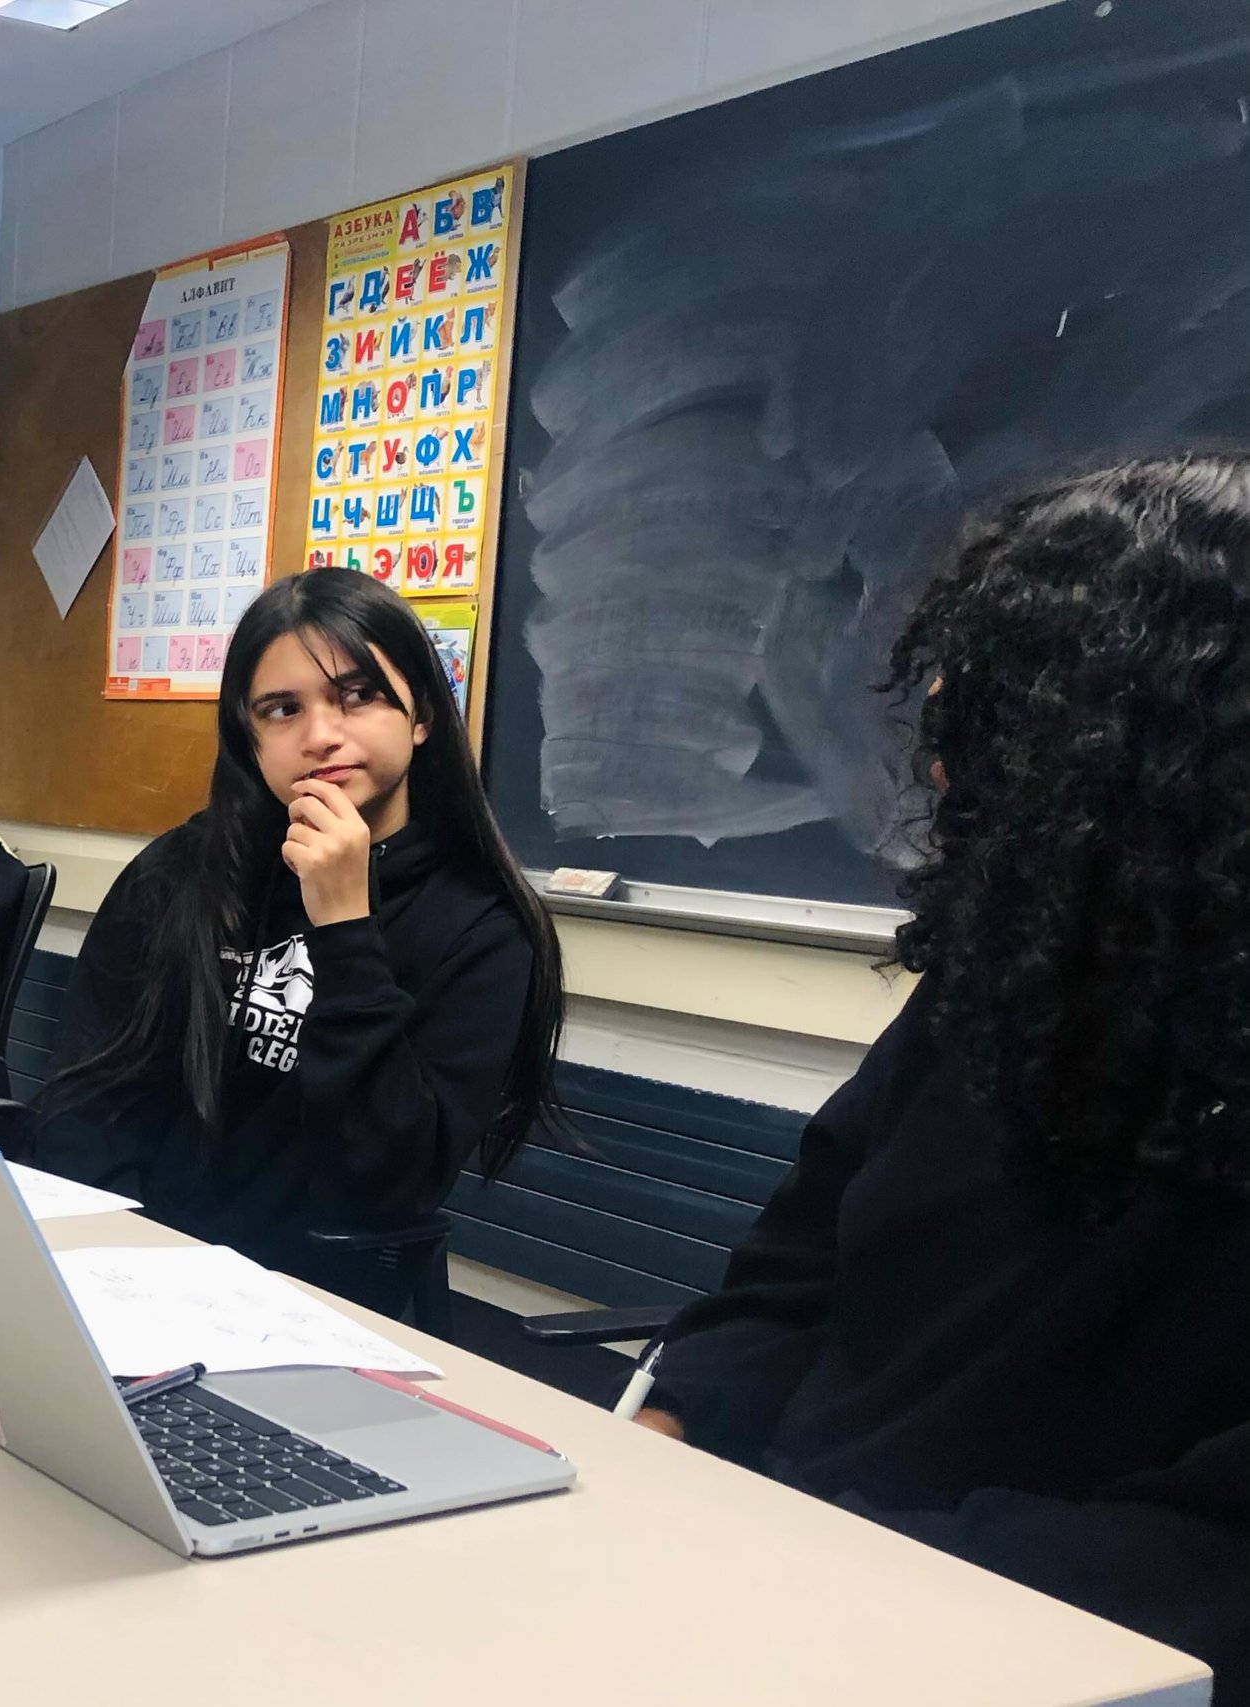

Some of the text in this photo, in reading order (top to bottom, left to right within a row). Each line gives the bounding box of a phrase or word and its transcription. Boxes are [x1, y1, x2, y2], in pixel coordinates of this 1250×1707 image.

[334, 209, 393, 239] АЗБУКА
[399, 188, 494, 245] А Б В
[180, 277, 236, 304] АЛФАВИТ
[328, 282, 345, 316] Г
[359, 270, 381, 310] Д
[394, 264, 414, 300] Е
[428, 250, 448, 293] Ё
[465, 243, 494, 282] Ж
[354, 329, 375, 364] И
[390, 316, 411, 357] Й
[423, 315, 444, 350] К
[460, 306, 484, 344] Л
[320, 368, 477, 425] М Н О П Р
[316, 427, 474, 479] С Т У Ф Х
[312, 480, 474, 532] Ц Ч Ш Щ Ъ
[372, 548, 392, 580] Э
[406, 545, 434, 579] Ю
[442, 543, 464, 577] Я
